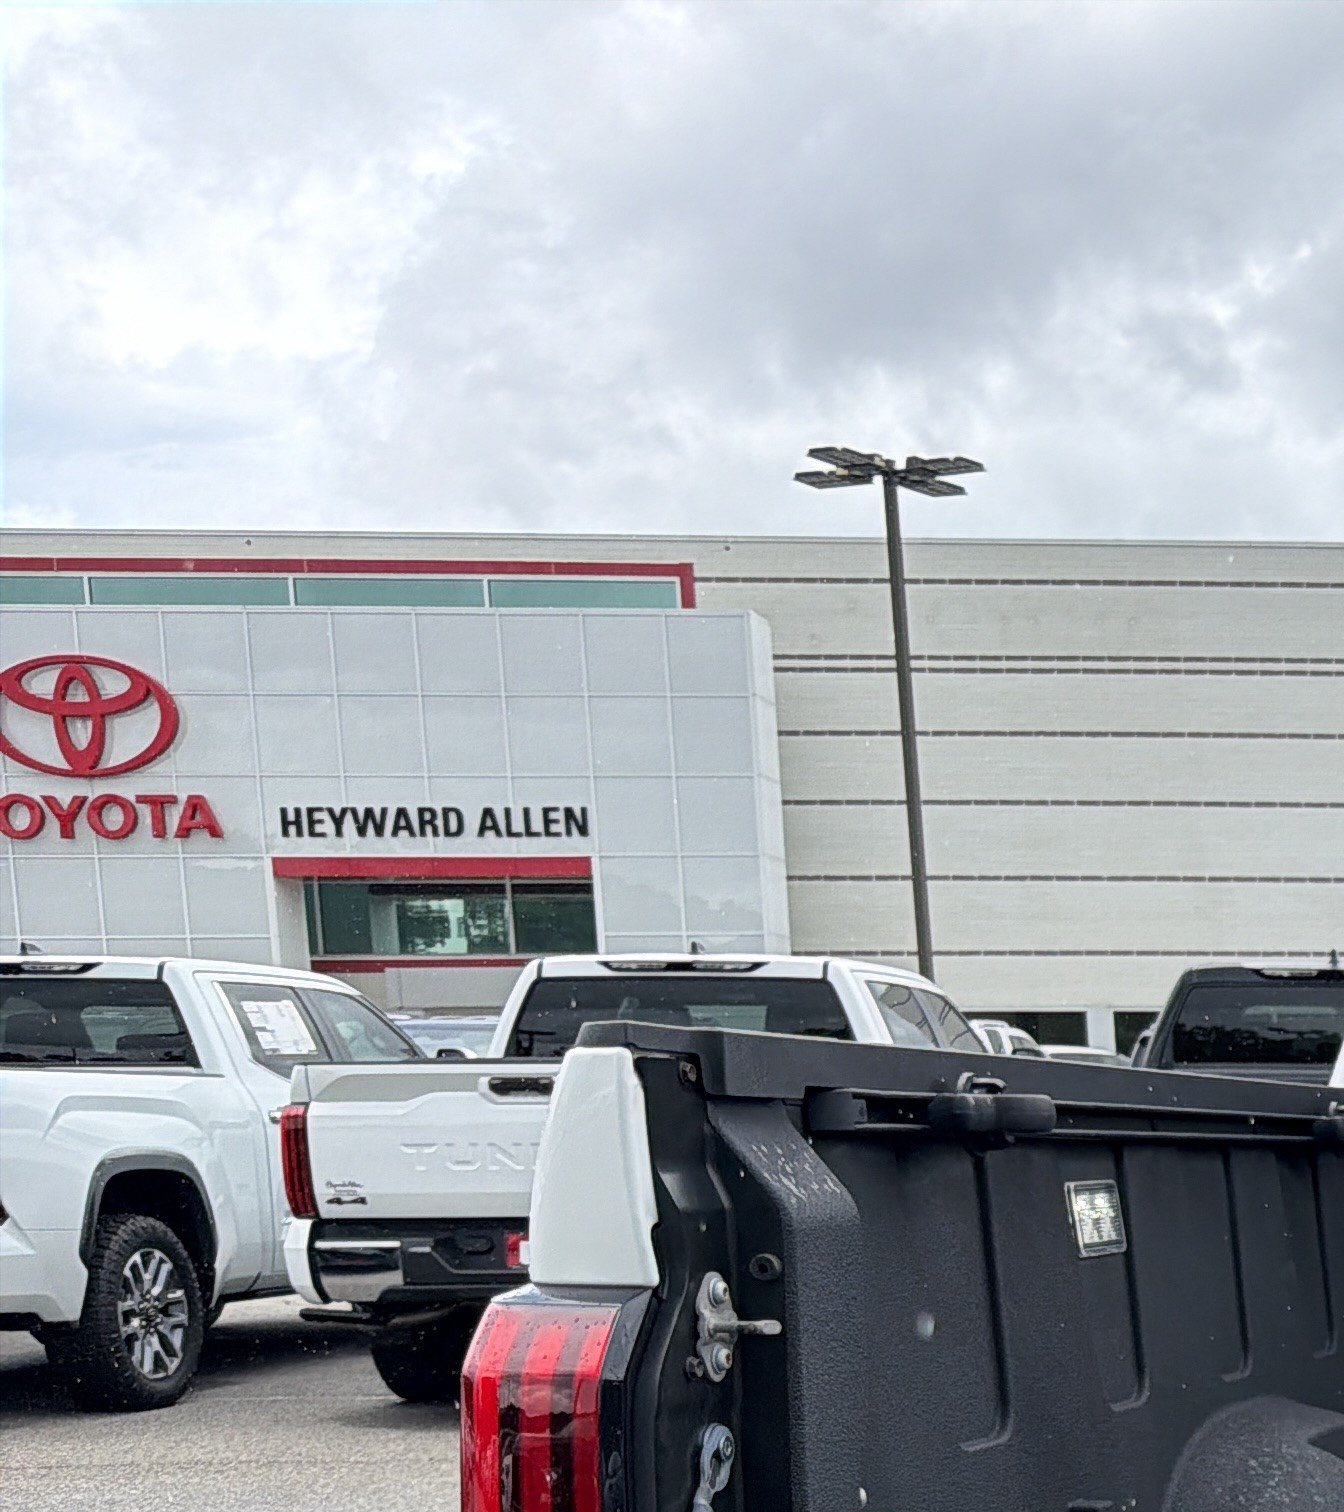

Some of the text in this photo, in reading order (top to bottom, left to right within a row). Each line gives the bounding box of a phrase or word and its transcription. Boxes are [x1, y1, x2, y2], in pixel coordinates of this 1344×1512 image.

[0, 793, 224, 840] OYOTA
[279, 806, 590, 838] HEYWARD ALLEN
